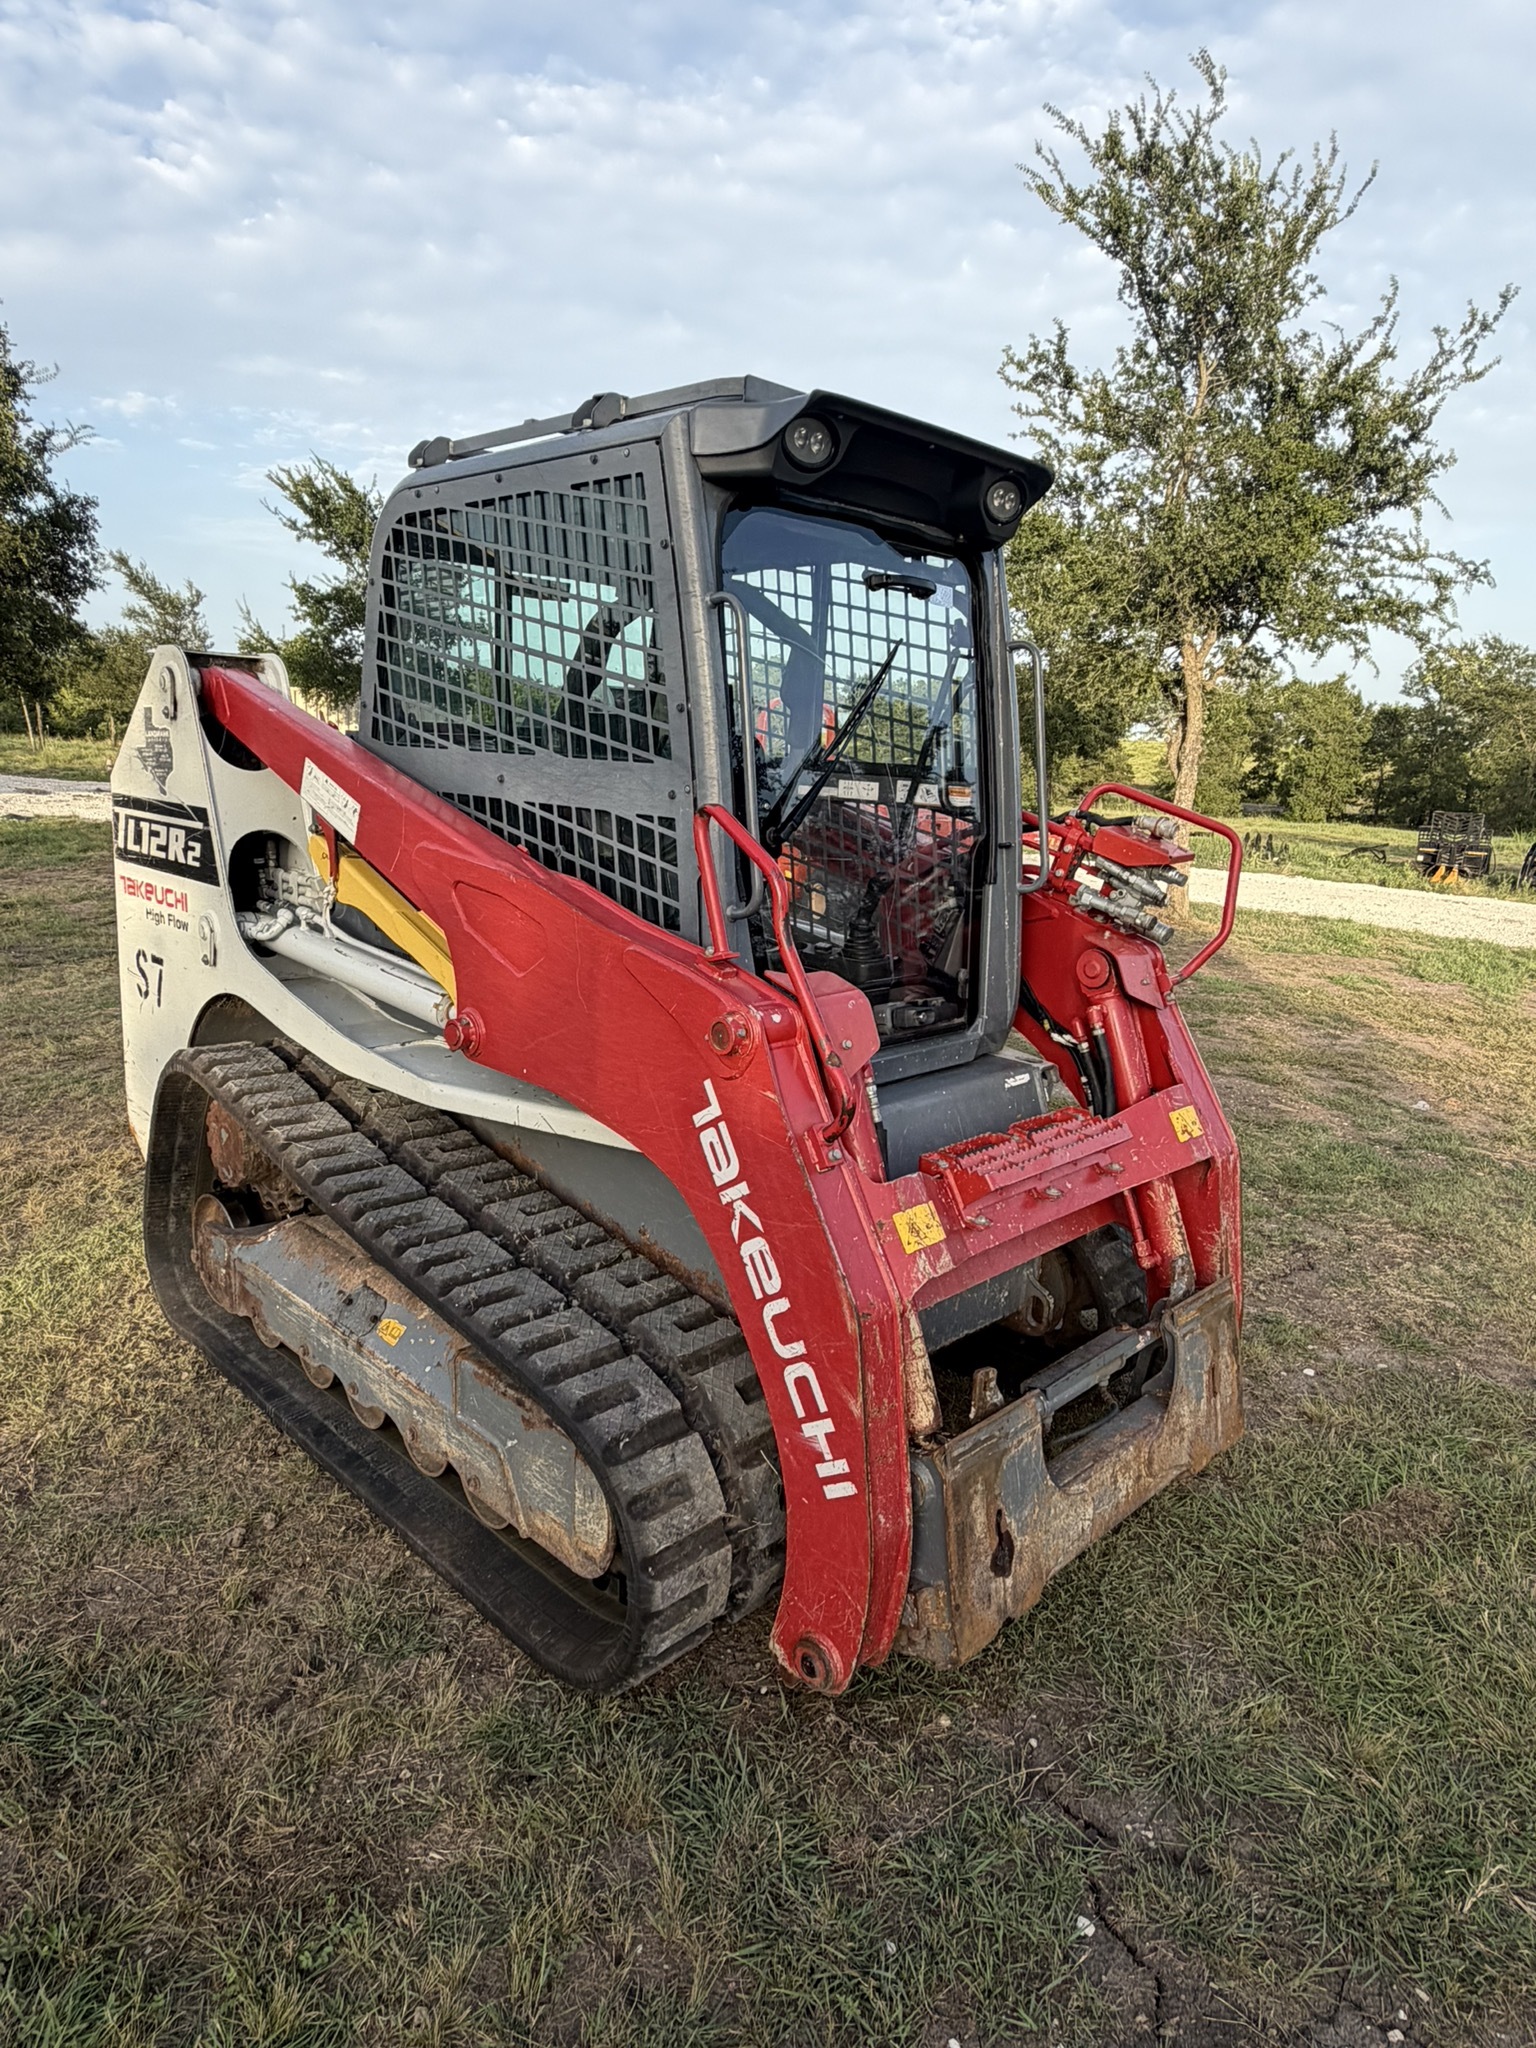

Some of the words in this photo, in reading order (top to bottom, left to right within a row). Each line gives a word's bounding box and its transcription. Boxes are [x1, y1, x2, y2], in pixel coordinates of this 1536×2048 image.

[113, 806, 204, 868] TL12R2
[145, 907, 166, 926] High
[168, 913, 189, 932] Flow
